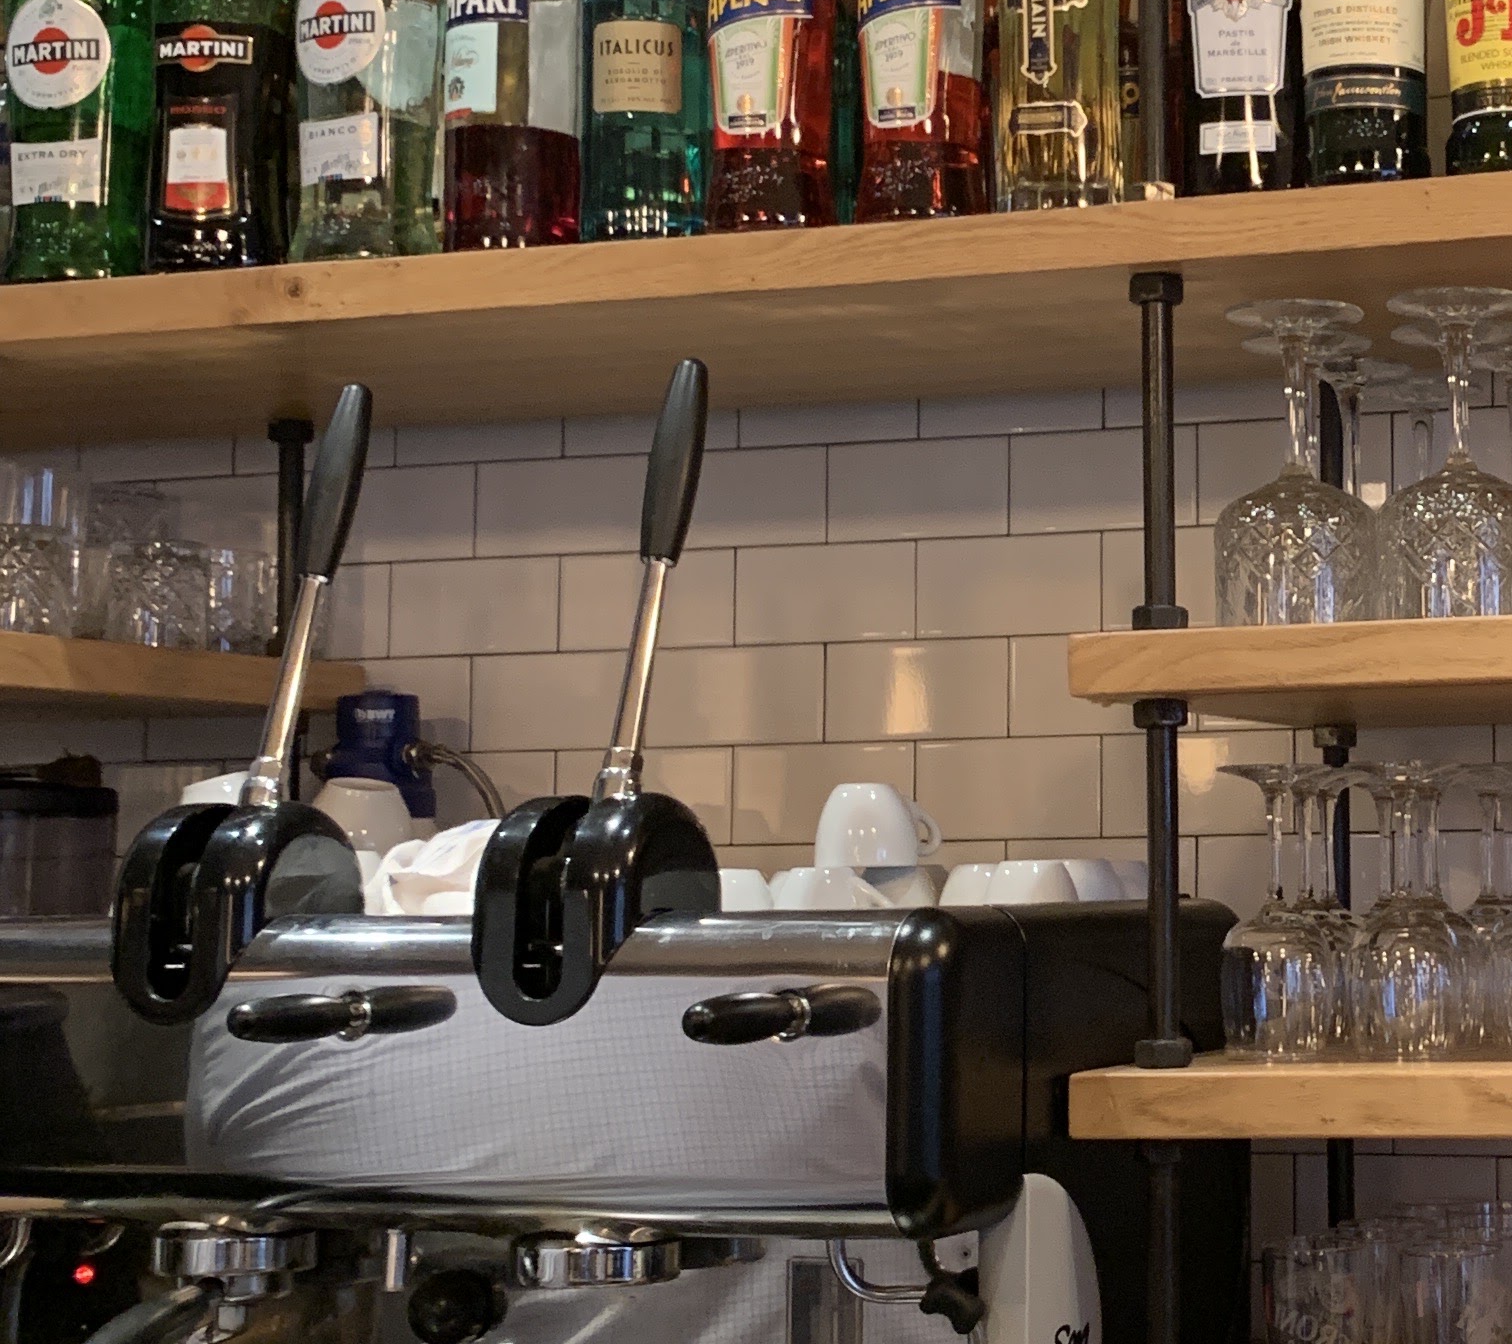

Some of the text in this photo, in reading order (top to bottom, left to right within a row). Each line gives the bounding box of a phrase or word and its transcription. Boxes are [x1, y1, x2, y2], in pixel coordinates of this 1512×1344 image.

[1345, 4, 1399, 16] DISTILLED
[300, 11, 374, 40] MARTINI
[159, 39, 245, 59] MARTINI
[599, 38, 675, 58] ITALICUS
[1318, 34, 1392, 47] IRISH WHISKEY
[13, 40, 98, 64] MARTINI
[1206, 47, 1268, 57] MARSEILLE
[308, 123, 358, 140] BIANCO
[17, 148, 88, 162] EXTRA DRY
